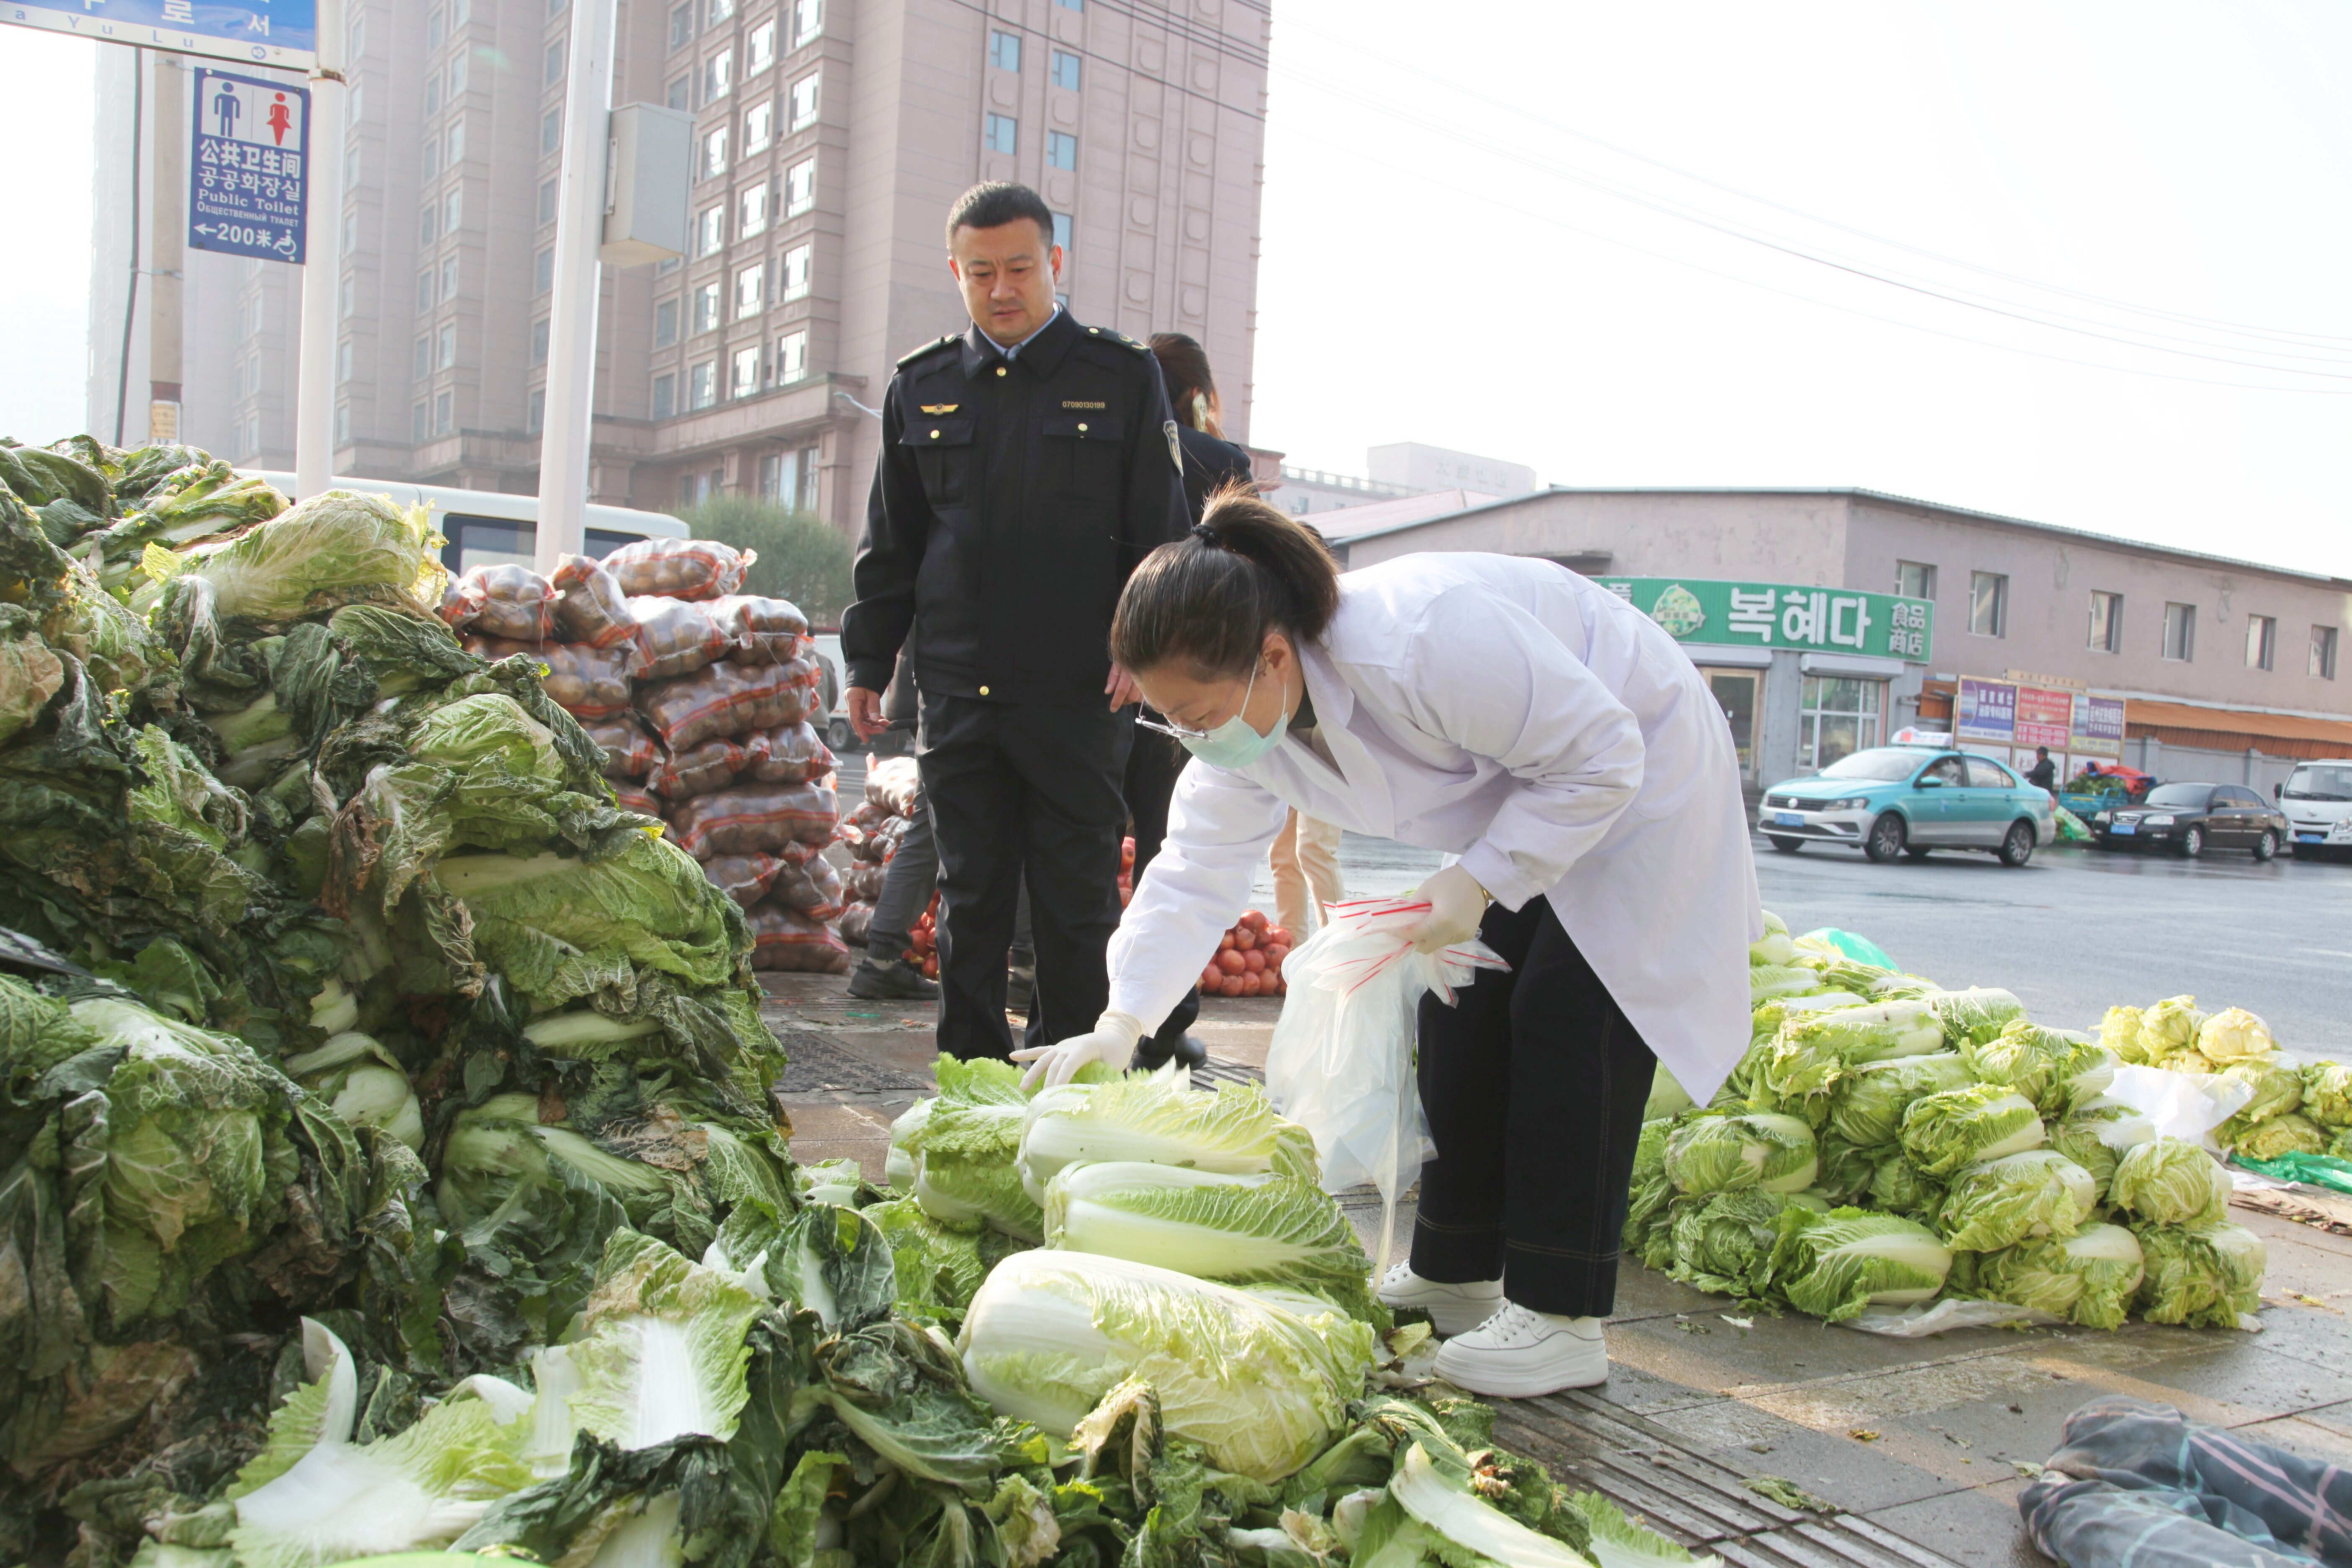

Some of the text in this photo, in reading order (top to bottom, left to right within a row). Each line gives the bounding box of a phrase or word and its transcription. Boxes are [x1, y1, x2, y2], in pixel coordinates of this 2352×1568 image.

[248, 15, 269, 36] 서
[200, 139, 301, 179] 公共卫生间
[198, 165, 300, 202] 공공화장실
[199, 188, 299, 216] Public Toilet
[217, 223, 272, 248] 200米
[1728, 587, 1872, 649] 복혜다
[1892, 602, 1925, 629] 食品
[1889, 627, 1924, 656] 商店
